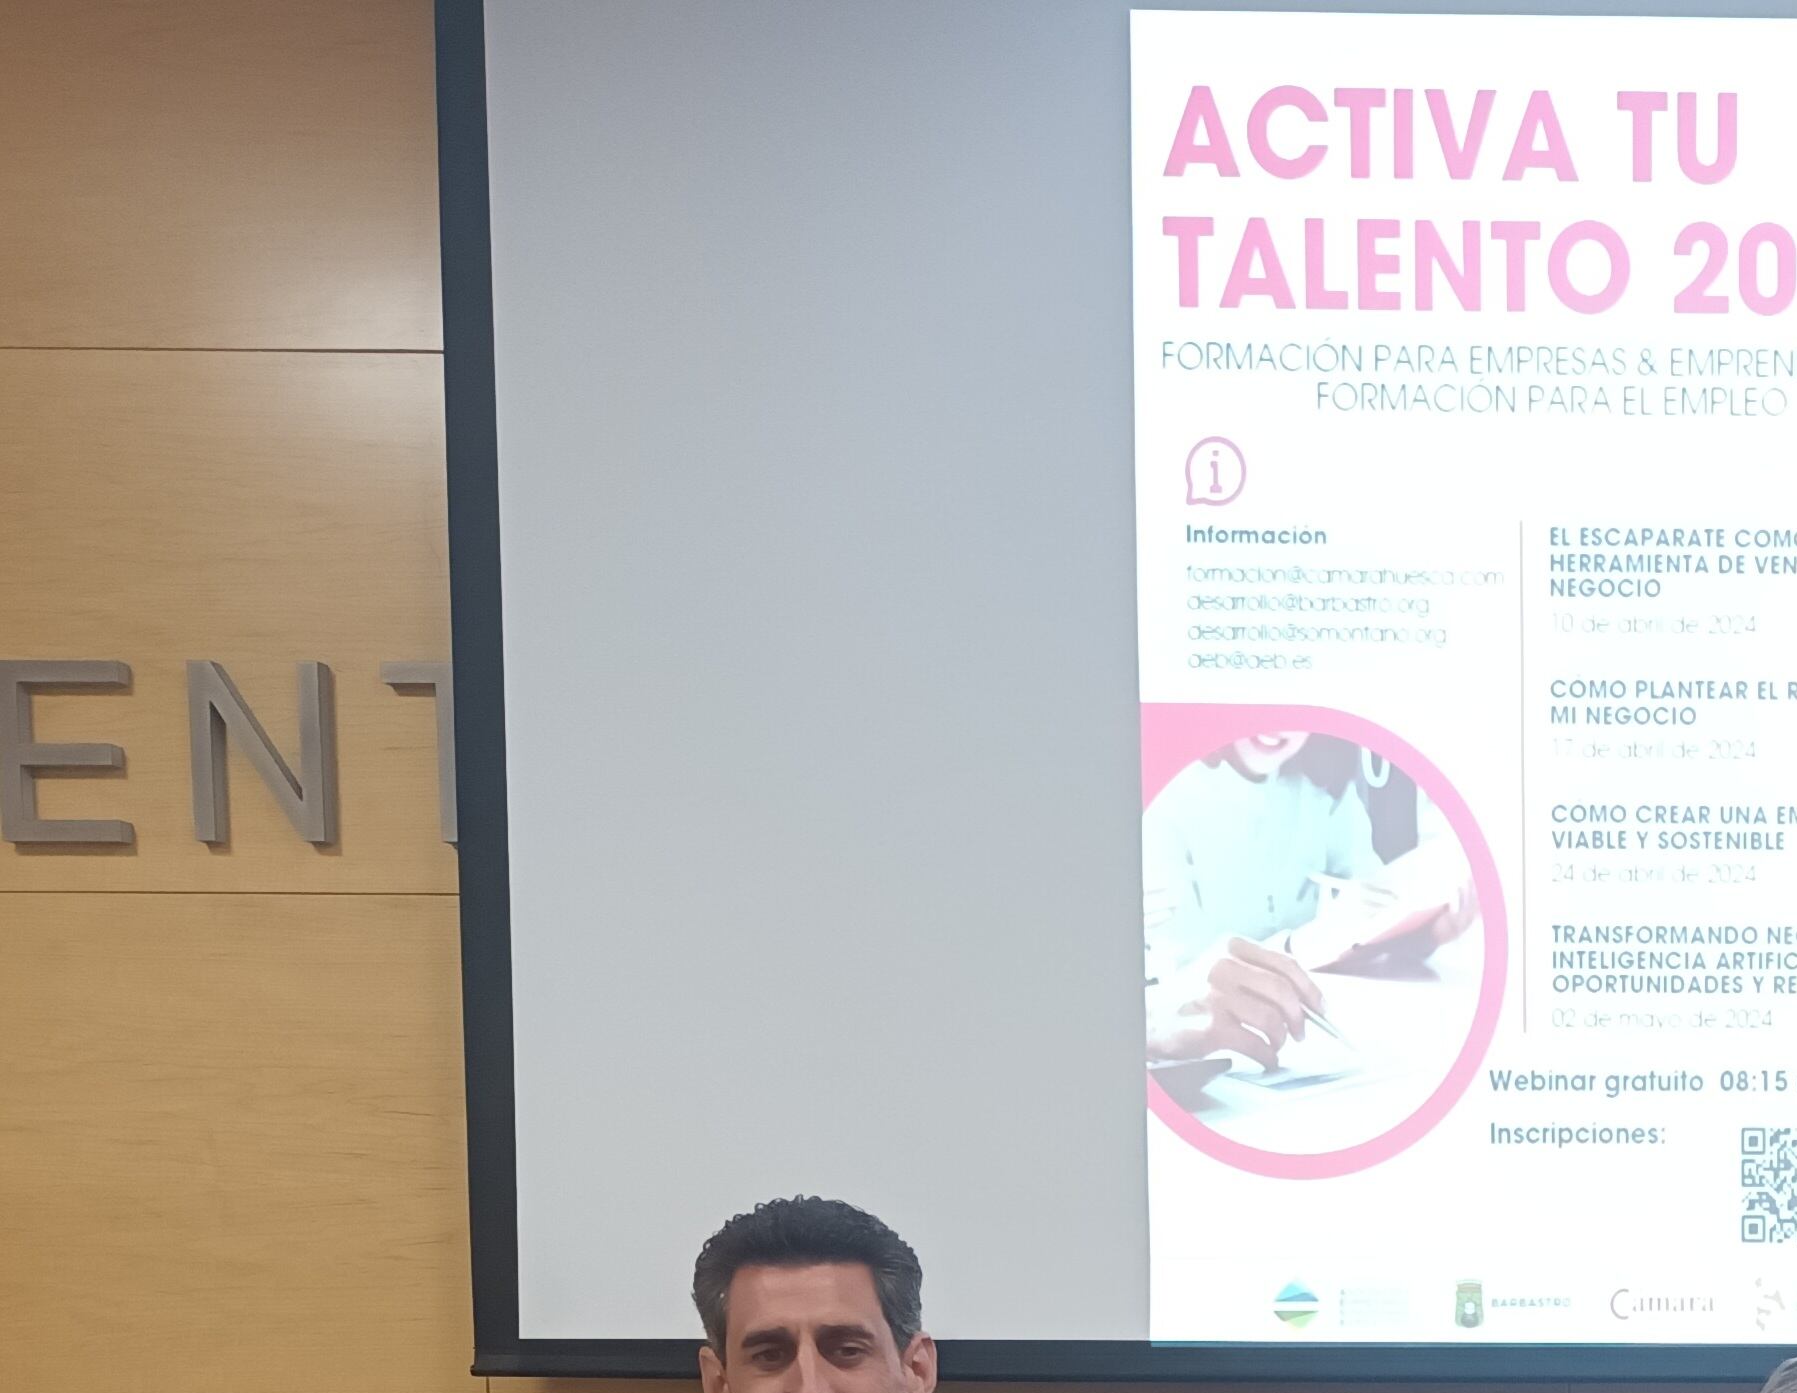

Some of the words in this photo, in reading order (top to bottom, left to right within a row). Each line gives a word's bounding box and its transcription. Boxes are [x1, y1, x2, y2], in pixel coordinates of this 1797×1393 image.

[1163, 84, 1579, 182] ACTIVA
[1616, 91, 1738, 185] TU
[1162, 216, 1630, 315] TALENTO
[1162, 333, 1362, 373] FORMACIÓN
[1374, 344, 1458, 373] PARA
[1470, 345, 1626, 375] EMPRESAS
[1637, 348, 1657, 376] &
[1317, 375, 1516, 413] FORMACIÓN
[1528, 384, 1611, 414] PARA
[1623, 386, 1652, 416] EL
[1664, 386, 1787, 416] EMPLEO
[1550, 527, 1571, 547] EL
[1580, 527, 1725, 548] ESCAPARATE
[1551, 925, 1758, 945] TRANSFORMANDO
[1489, 1070, 1596, 1091] Webinar
[1604, 1070, 1704, 1098] gratuito
[1720, 1070, 1788, 1092] 08:15
[1490, 1122, 1665, 1148] Inscripciones:
